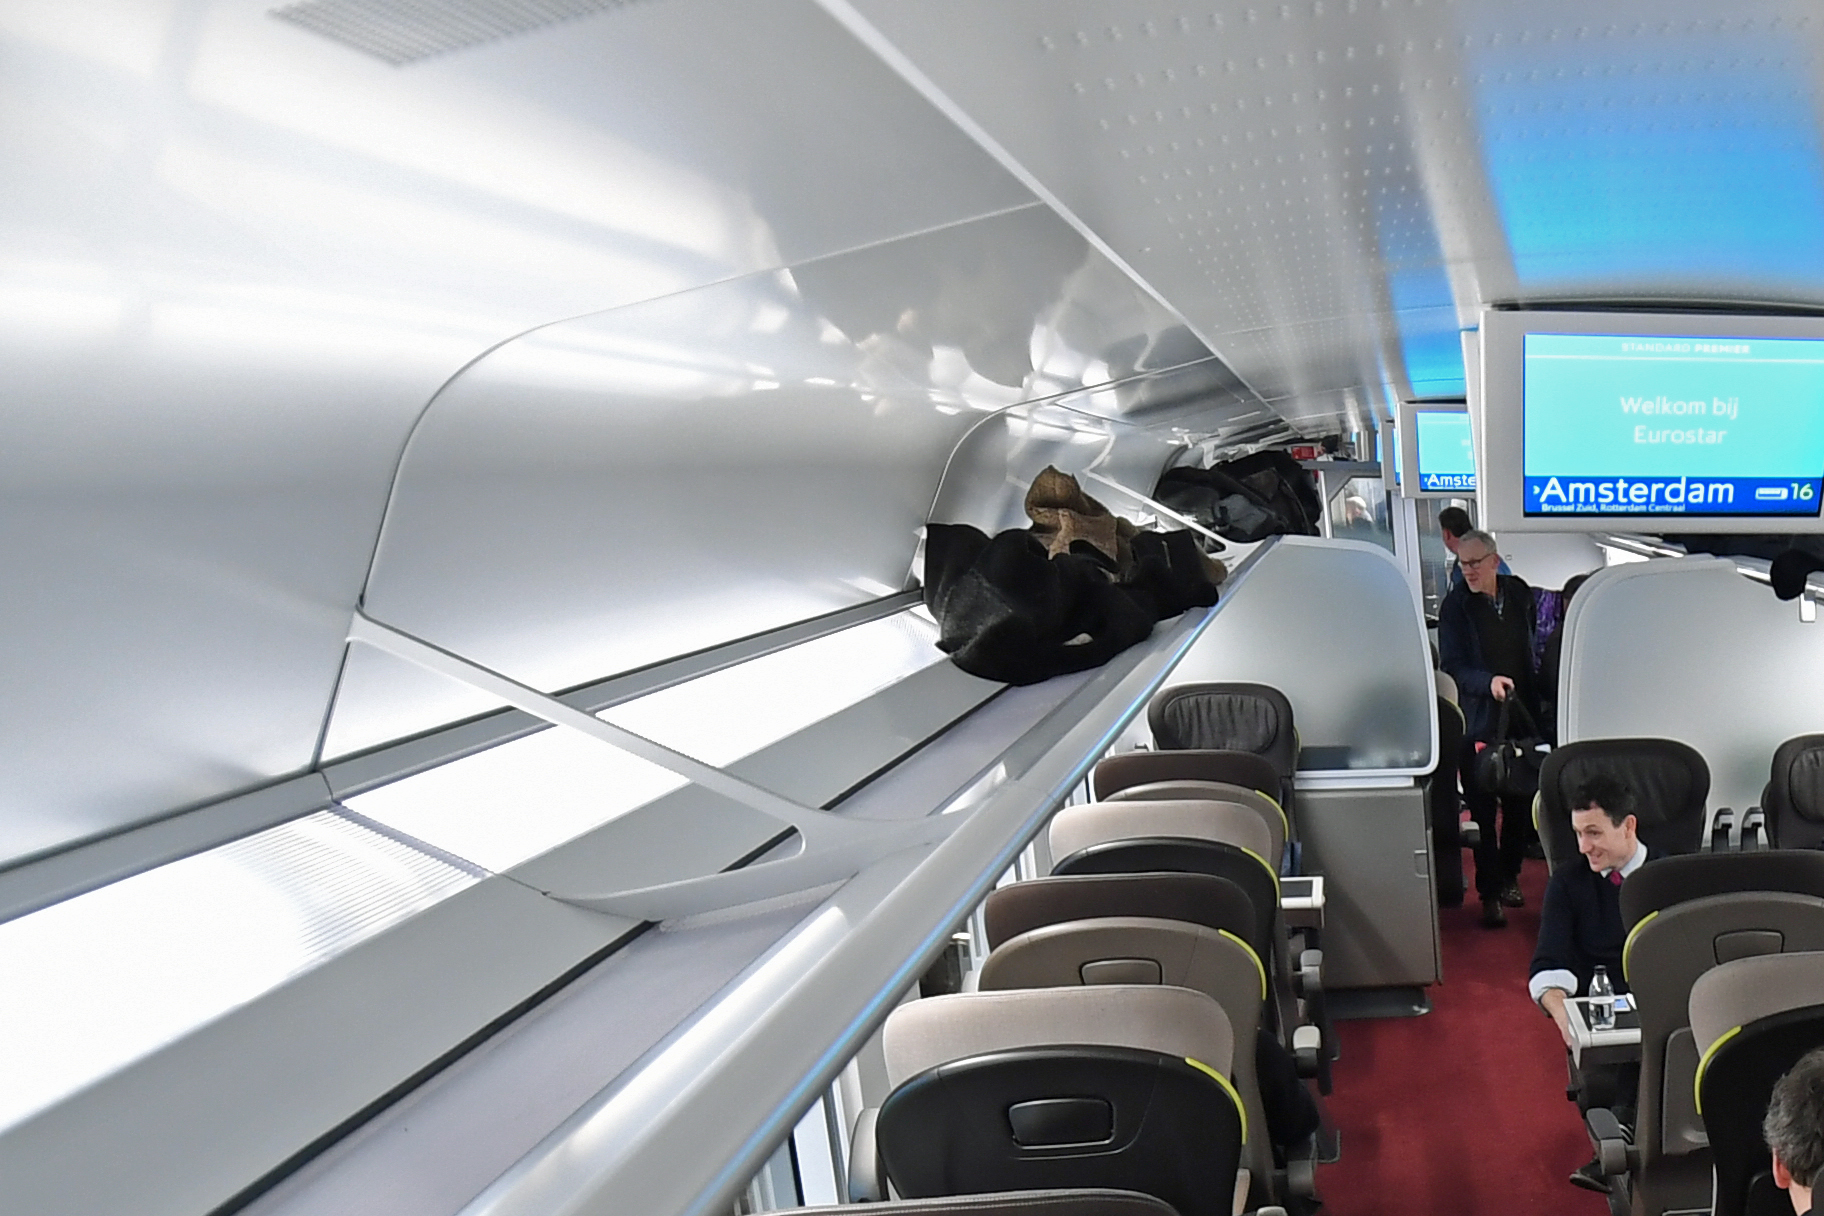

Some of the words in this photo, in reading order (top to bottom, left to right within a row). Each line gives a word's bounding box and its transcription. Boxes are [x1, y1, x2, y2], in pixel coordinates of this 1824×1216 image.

[1621, 342, 1691, 354] STANDARD
[1694, 344, 1751, 355] PREMIER
[1620, 396, 1706, 416] Welkom
[1712, 396, 1739, 421] bij
[1633, 425, 1727, 445] Eurostar
[1539, 476, 1735, 503] Amsterdam
[1791, 482, 1814, 500] 16
[1541, 503, 1575, 512] Brussel
[1576, 503, 1599, 513] Zuid,
[1600, 503, 1647, 512] Rotterdam
[1648, 503, 1685, 512] Centraal
